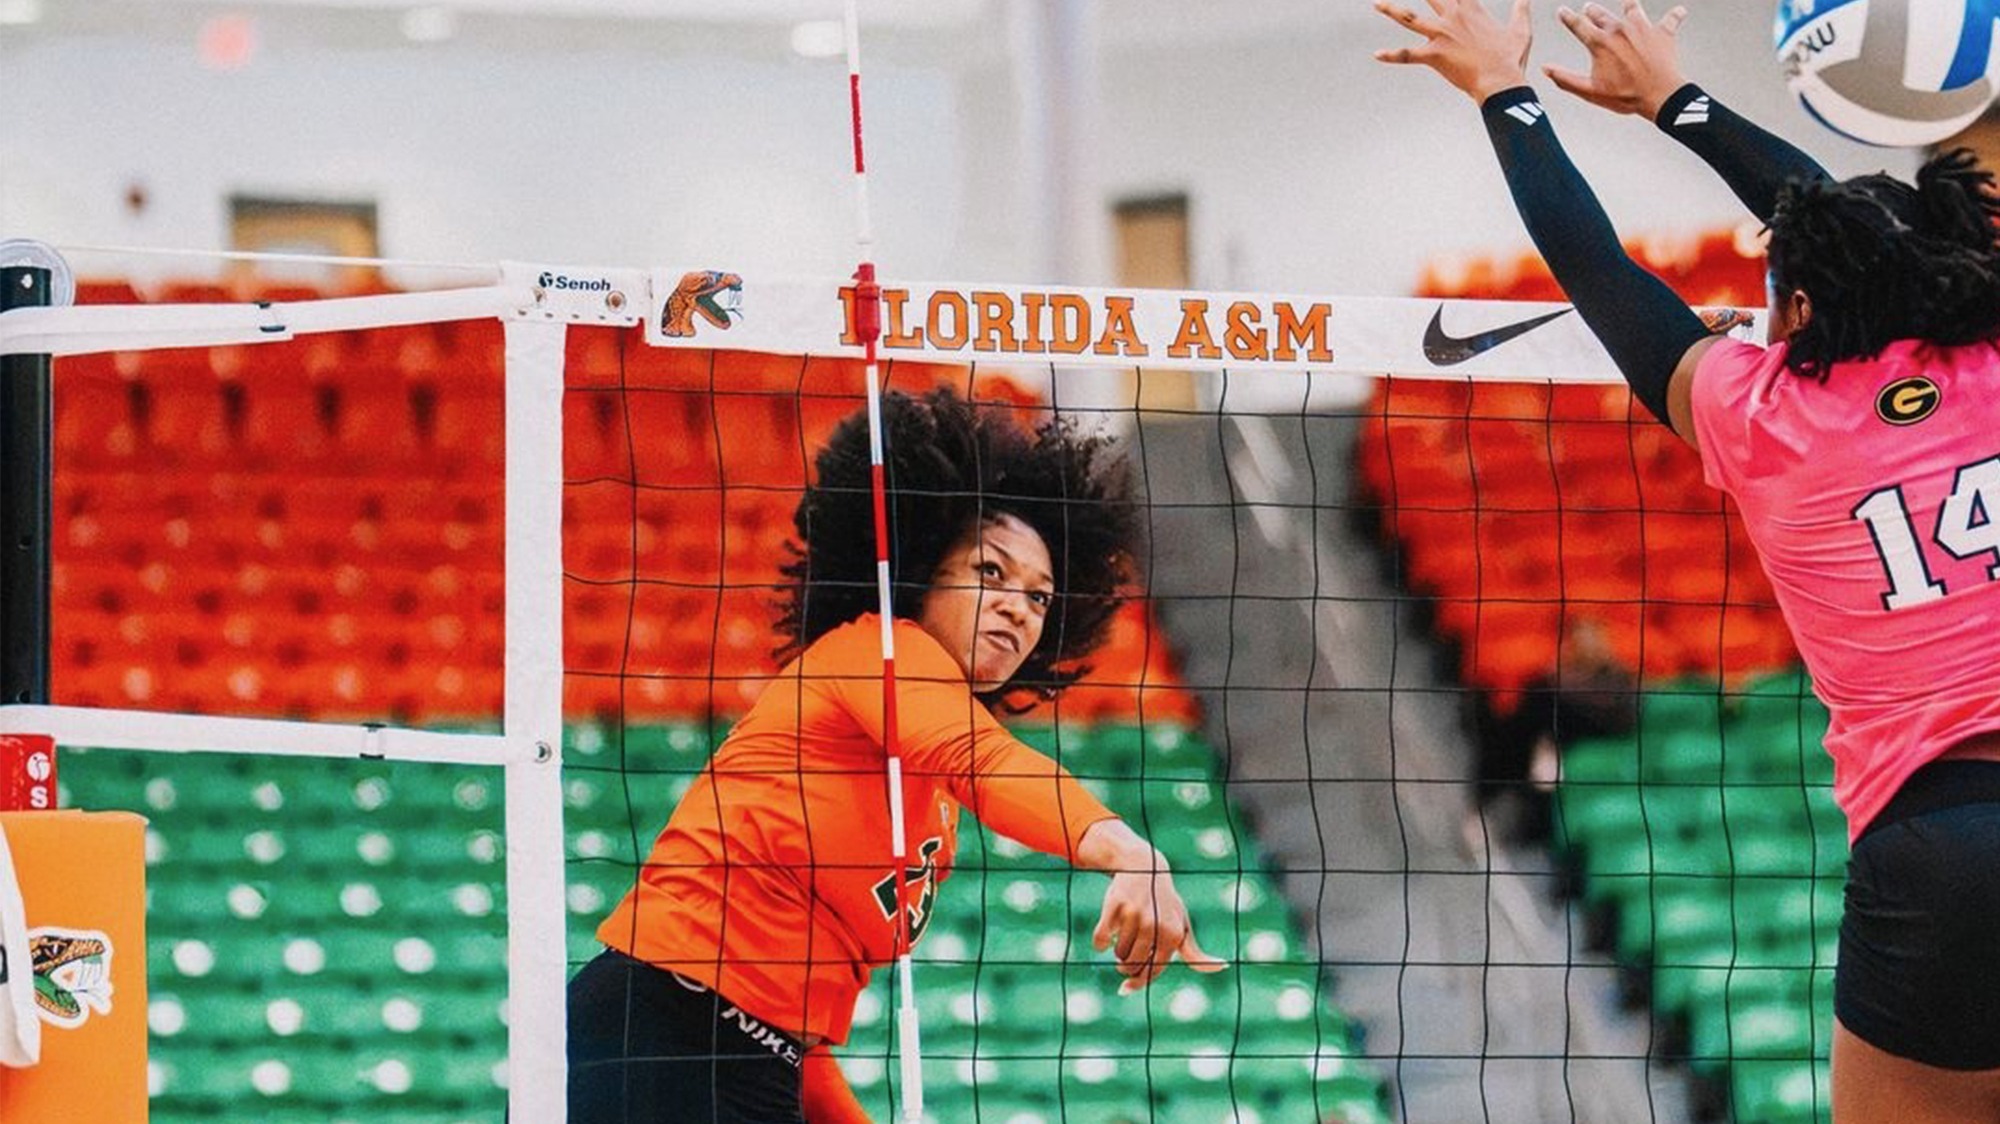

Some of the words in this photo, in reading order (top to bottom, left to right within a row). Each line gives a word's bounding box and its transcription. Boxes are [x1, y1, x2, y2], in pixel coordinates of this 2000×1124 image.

[556, 275, 612, 291] Senoh
[1167, 298, 1335, 363] A&M
[1875, 376, 1942, 426] G
[1850, 453, 2000, 612] 14
[720, 1006, 799, 1064] NIKE
